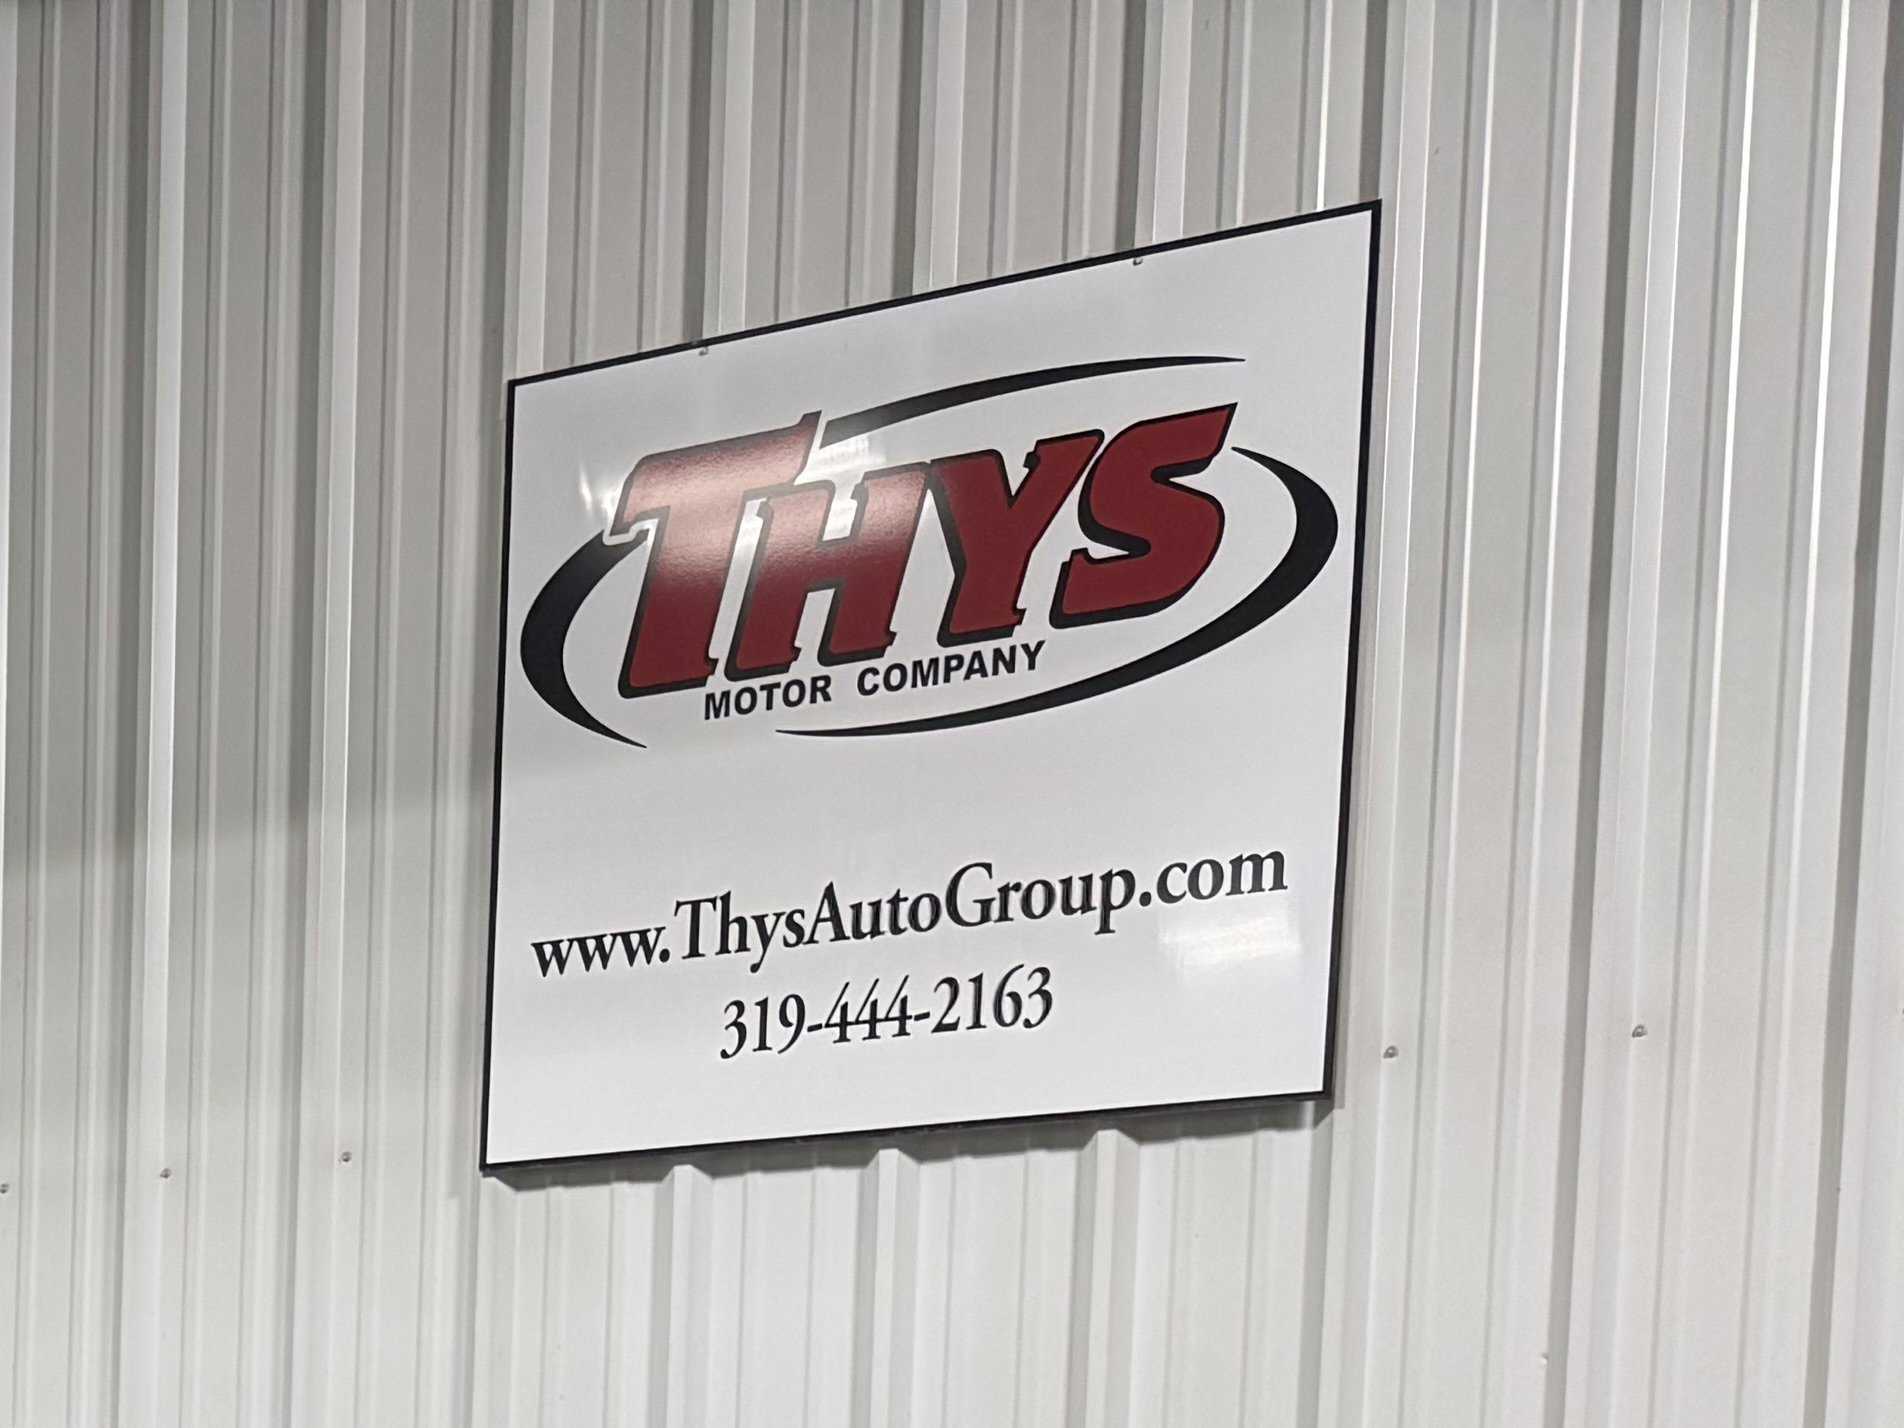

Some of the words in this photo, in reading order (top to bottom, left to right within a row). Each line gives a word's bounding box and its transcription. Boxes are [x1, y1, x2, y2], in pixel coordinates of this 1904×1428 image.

[610, 405, 1238, 698] THYS
[703, 673, 833, 722] MOTOR
[856, 640, 1047, 697] COMPANY
[529, 848, 1289, 978] www.ThysAutoGroup.com
[719, 962, 1054, 1060] 319-444-2163
